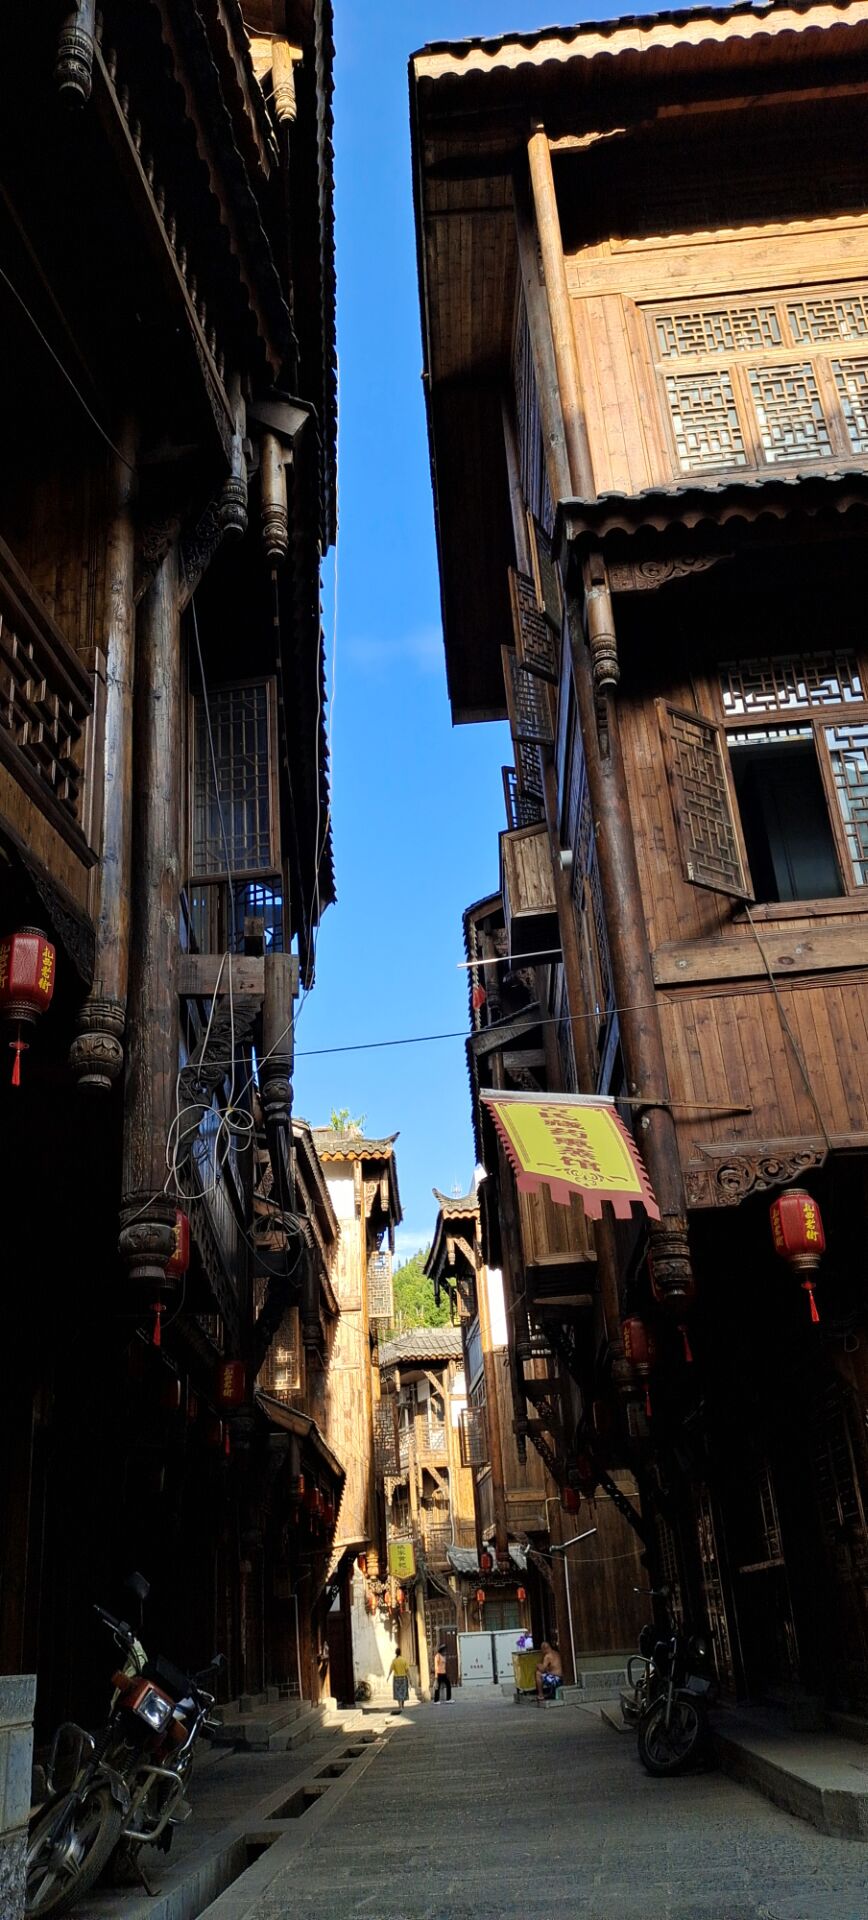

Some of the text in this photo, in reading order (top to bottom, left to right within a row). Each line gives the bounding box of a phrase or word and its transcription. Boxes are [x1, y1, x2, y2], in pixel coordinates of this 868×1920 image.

[39, 945, 54, 993] 扎西老街
[803, 1202, 819, 1242] 扎西老街
